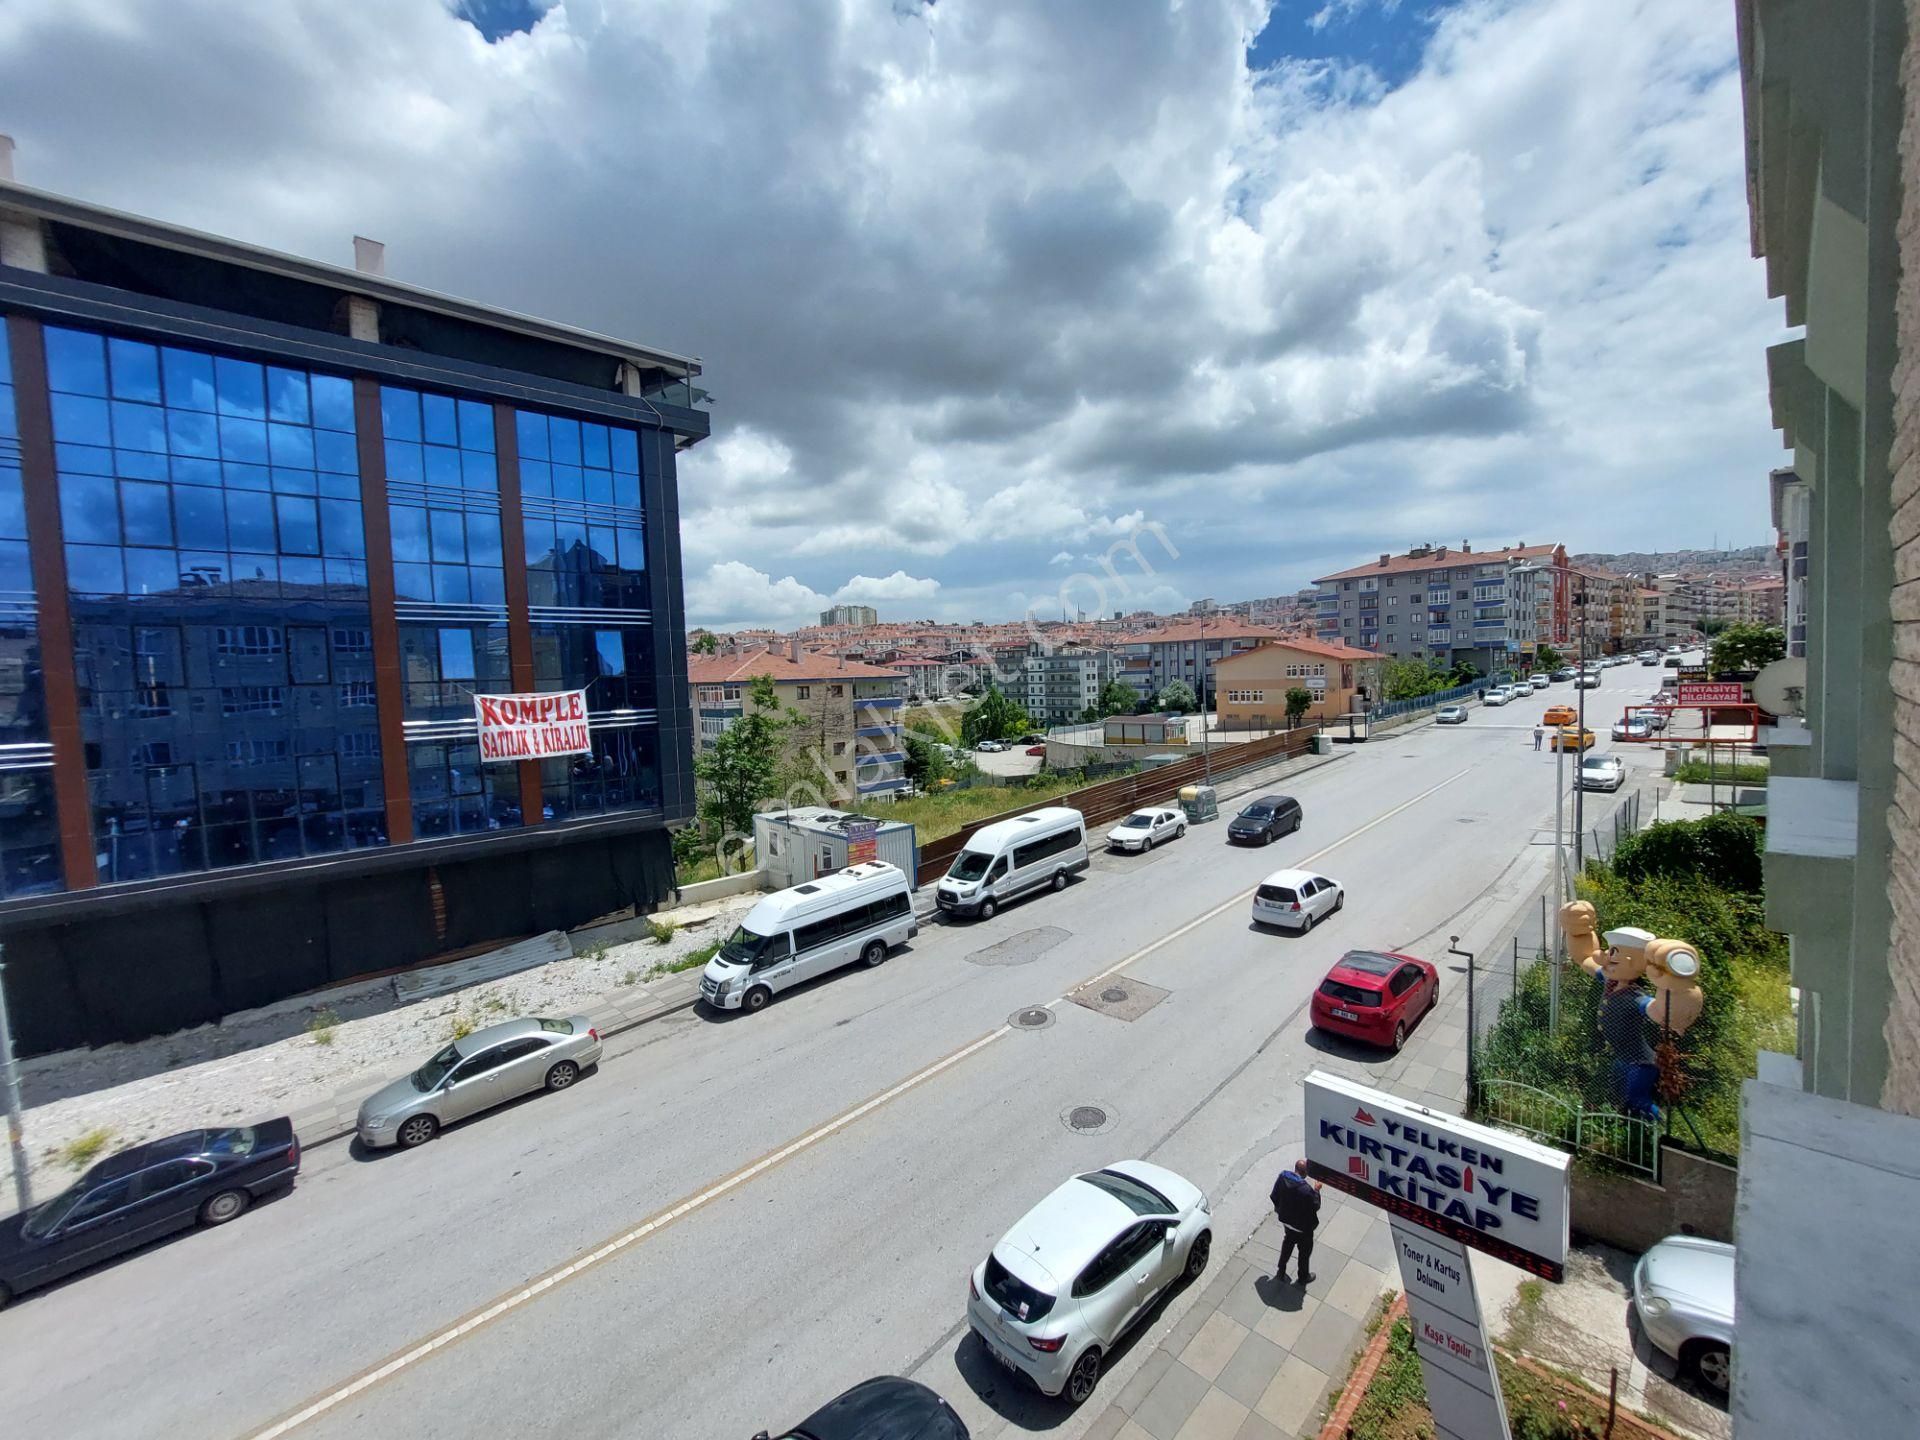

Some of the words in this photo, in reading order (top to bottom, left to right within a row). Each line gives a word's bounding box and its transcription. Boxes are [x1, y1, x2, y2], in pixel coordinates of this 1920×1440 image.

[1681, 685, 1739, 693] KIRTASİYE
[1681, 692, 1738, 701] BİLGİSAYAR
[479, 692, 584, 727] KOMPLE
[482, 730, 531, 759] SATILIK
[532, 729, 540, 755] &
[542, 722, 590, 753] KİRALIK
[1382, 1118, 1503, 1175] YELKEN
[1377, 1169, 1503, 1232] KİTAP
[1402, 1243, 1425, 1264] Toner
[1426, 1254, 1432, 1268] &
[1434, 1258, 1461, 1286] Kartuş
[1416, 1268, 1445, 1294] Dolumu
[1424, 1322, 1444, 1345] Kaşe
[1446, 1334, 1473, 1360] Yapılır
